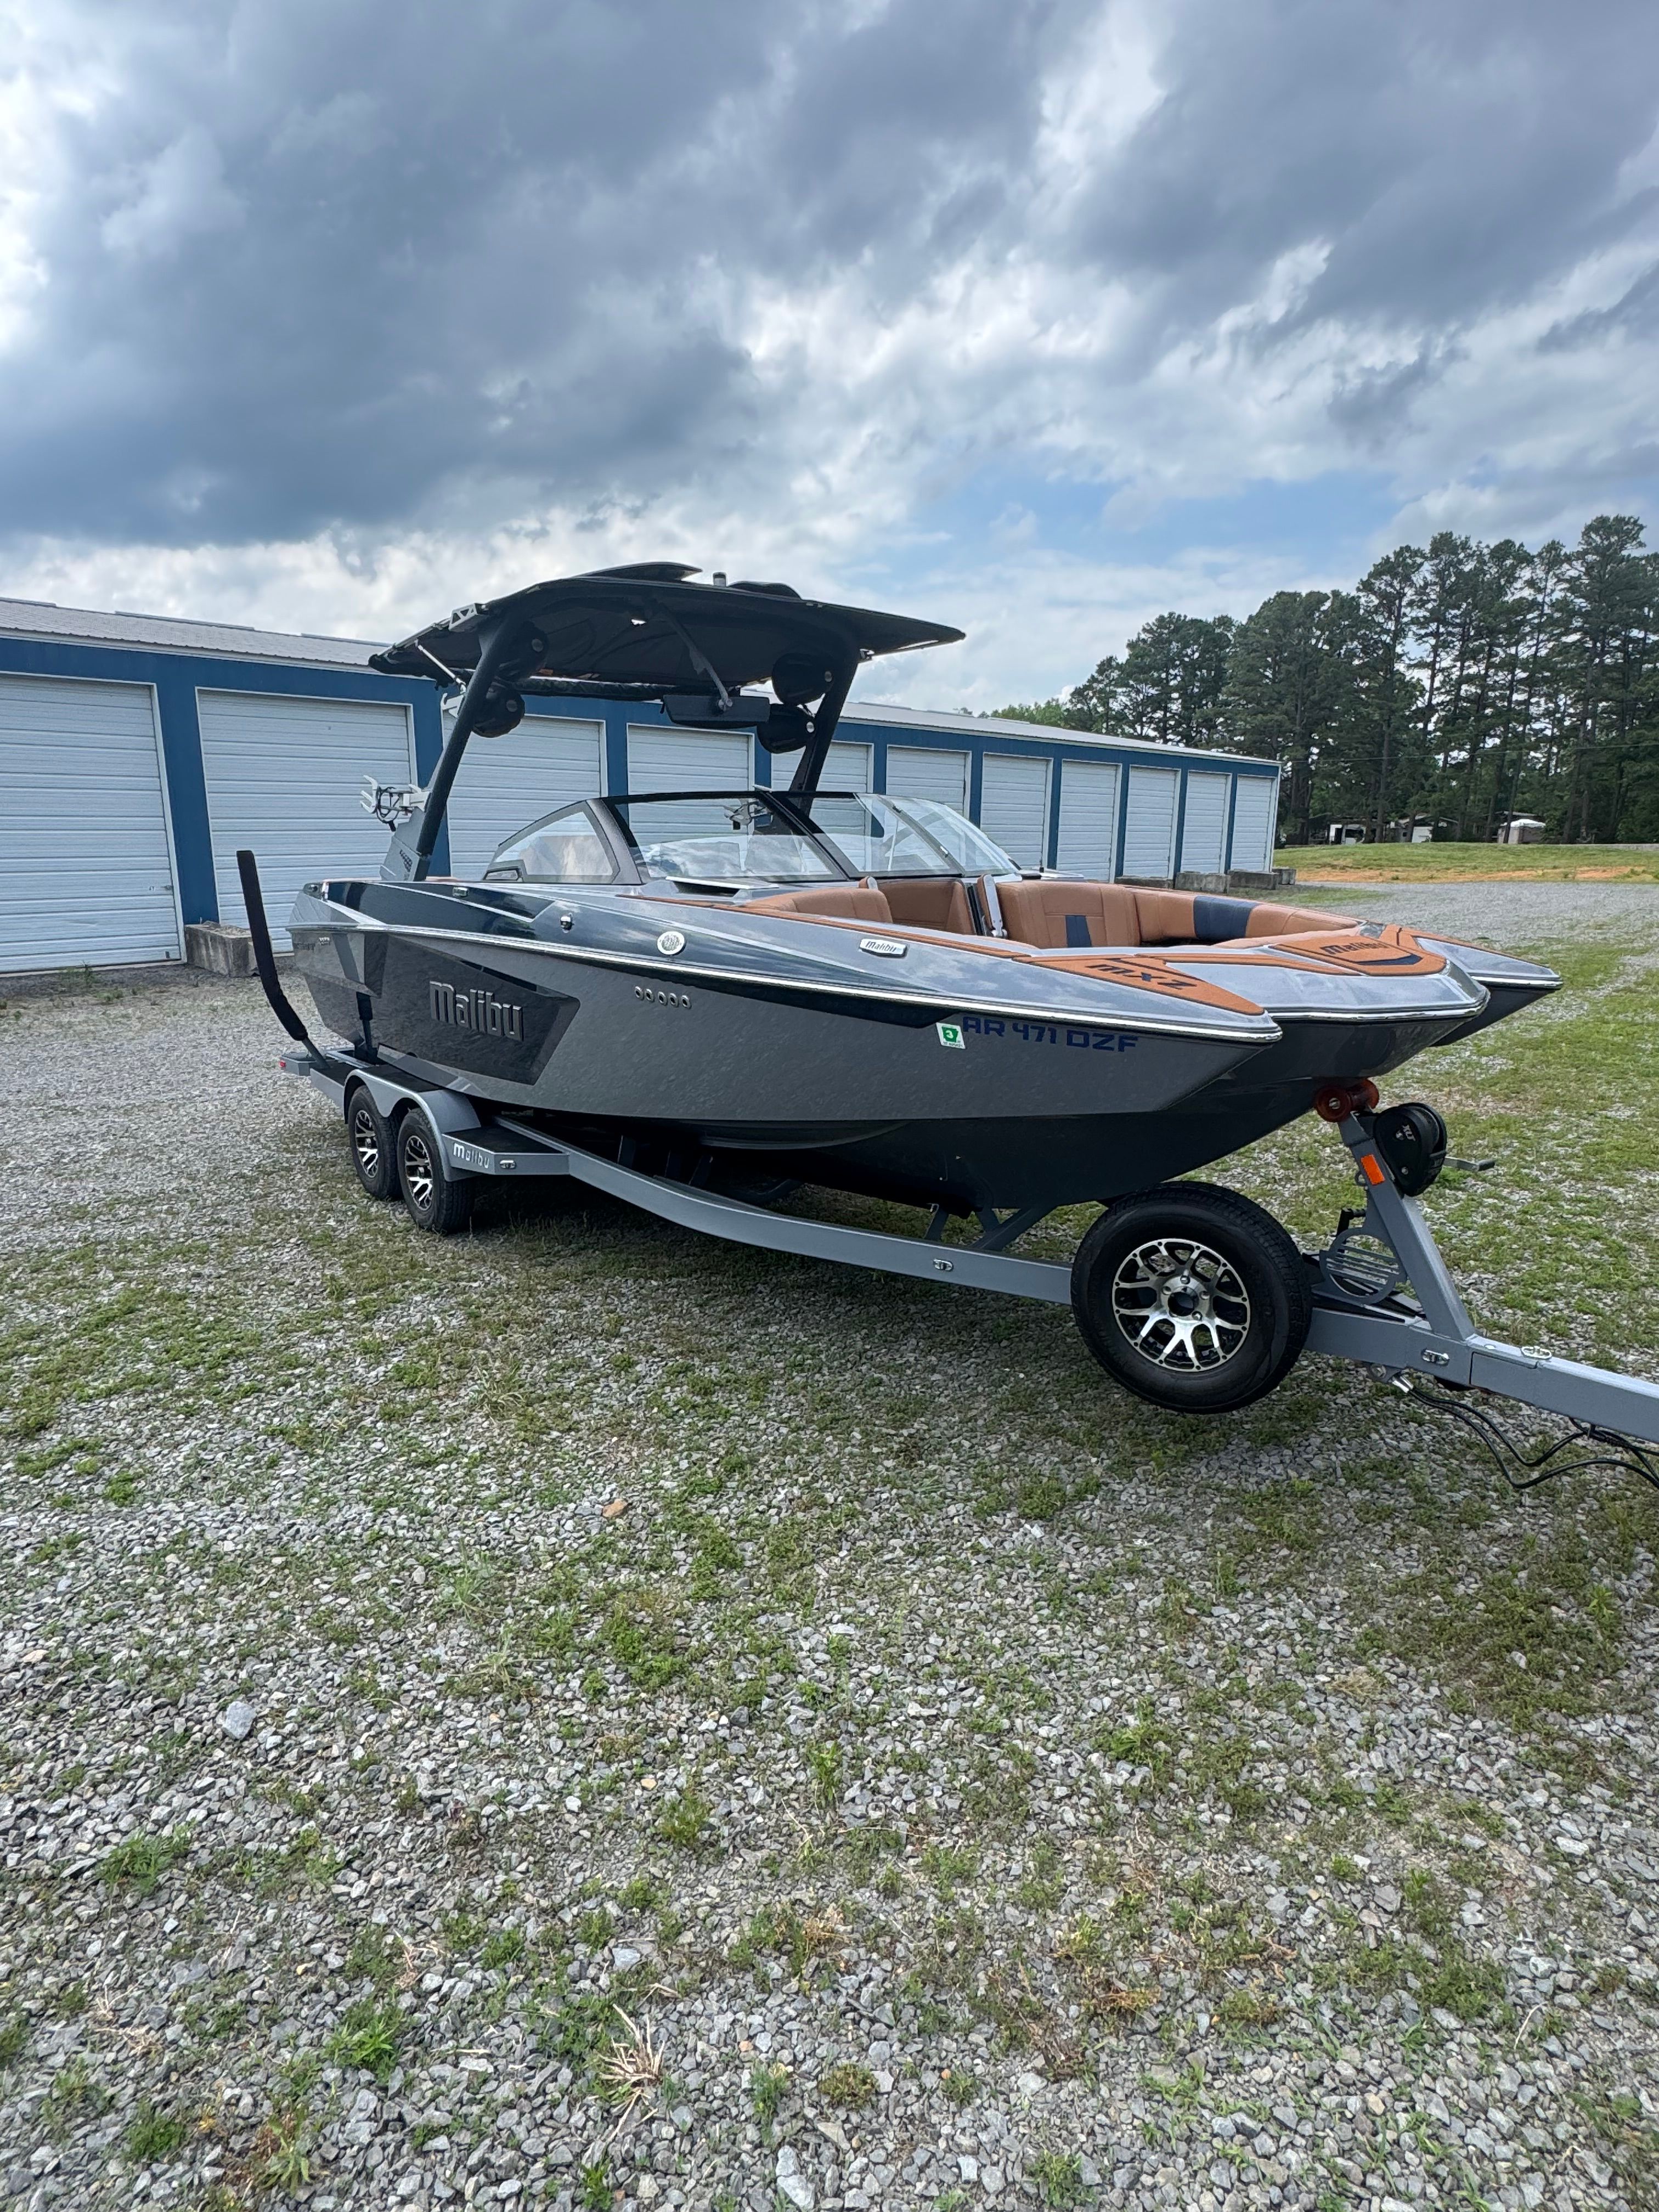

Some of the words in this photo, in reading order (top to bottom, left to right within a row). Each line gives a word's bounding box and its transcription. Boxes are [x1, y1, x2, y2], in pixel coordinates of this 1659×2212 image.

[865, 941, 897, 952] Malibu
[1319, 942, 1390, 955] Malibu
[430, 980, 524, 1042] Malibu
[962, 1016, 1005, 1037] AR
[1012, 1022, 1057, 1044] 471
[1066, 1029, 1139, 1052] DZF
[453, 1142, 489, 1169] Malibu
